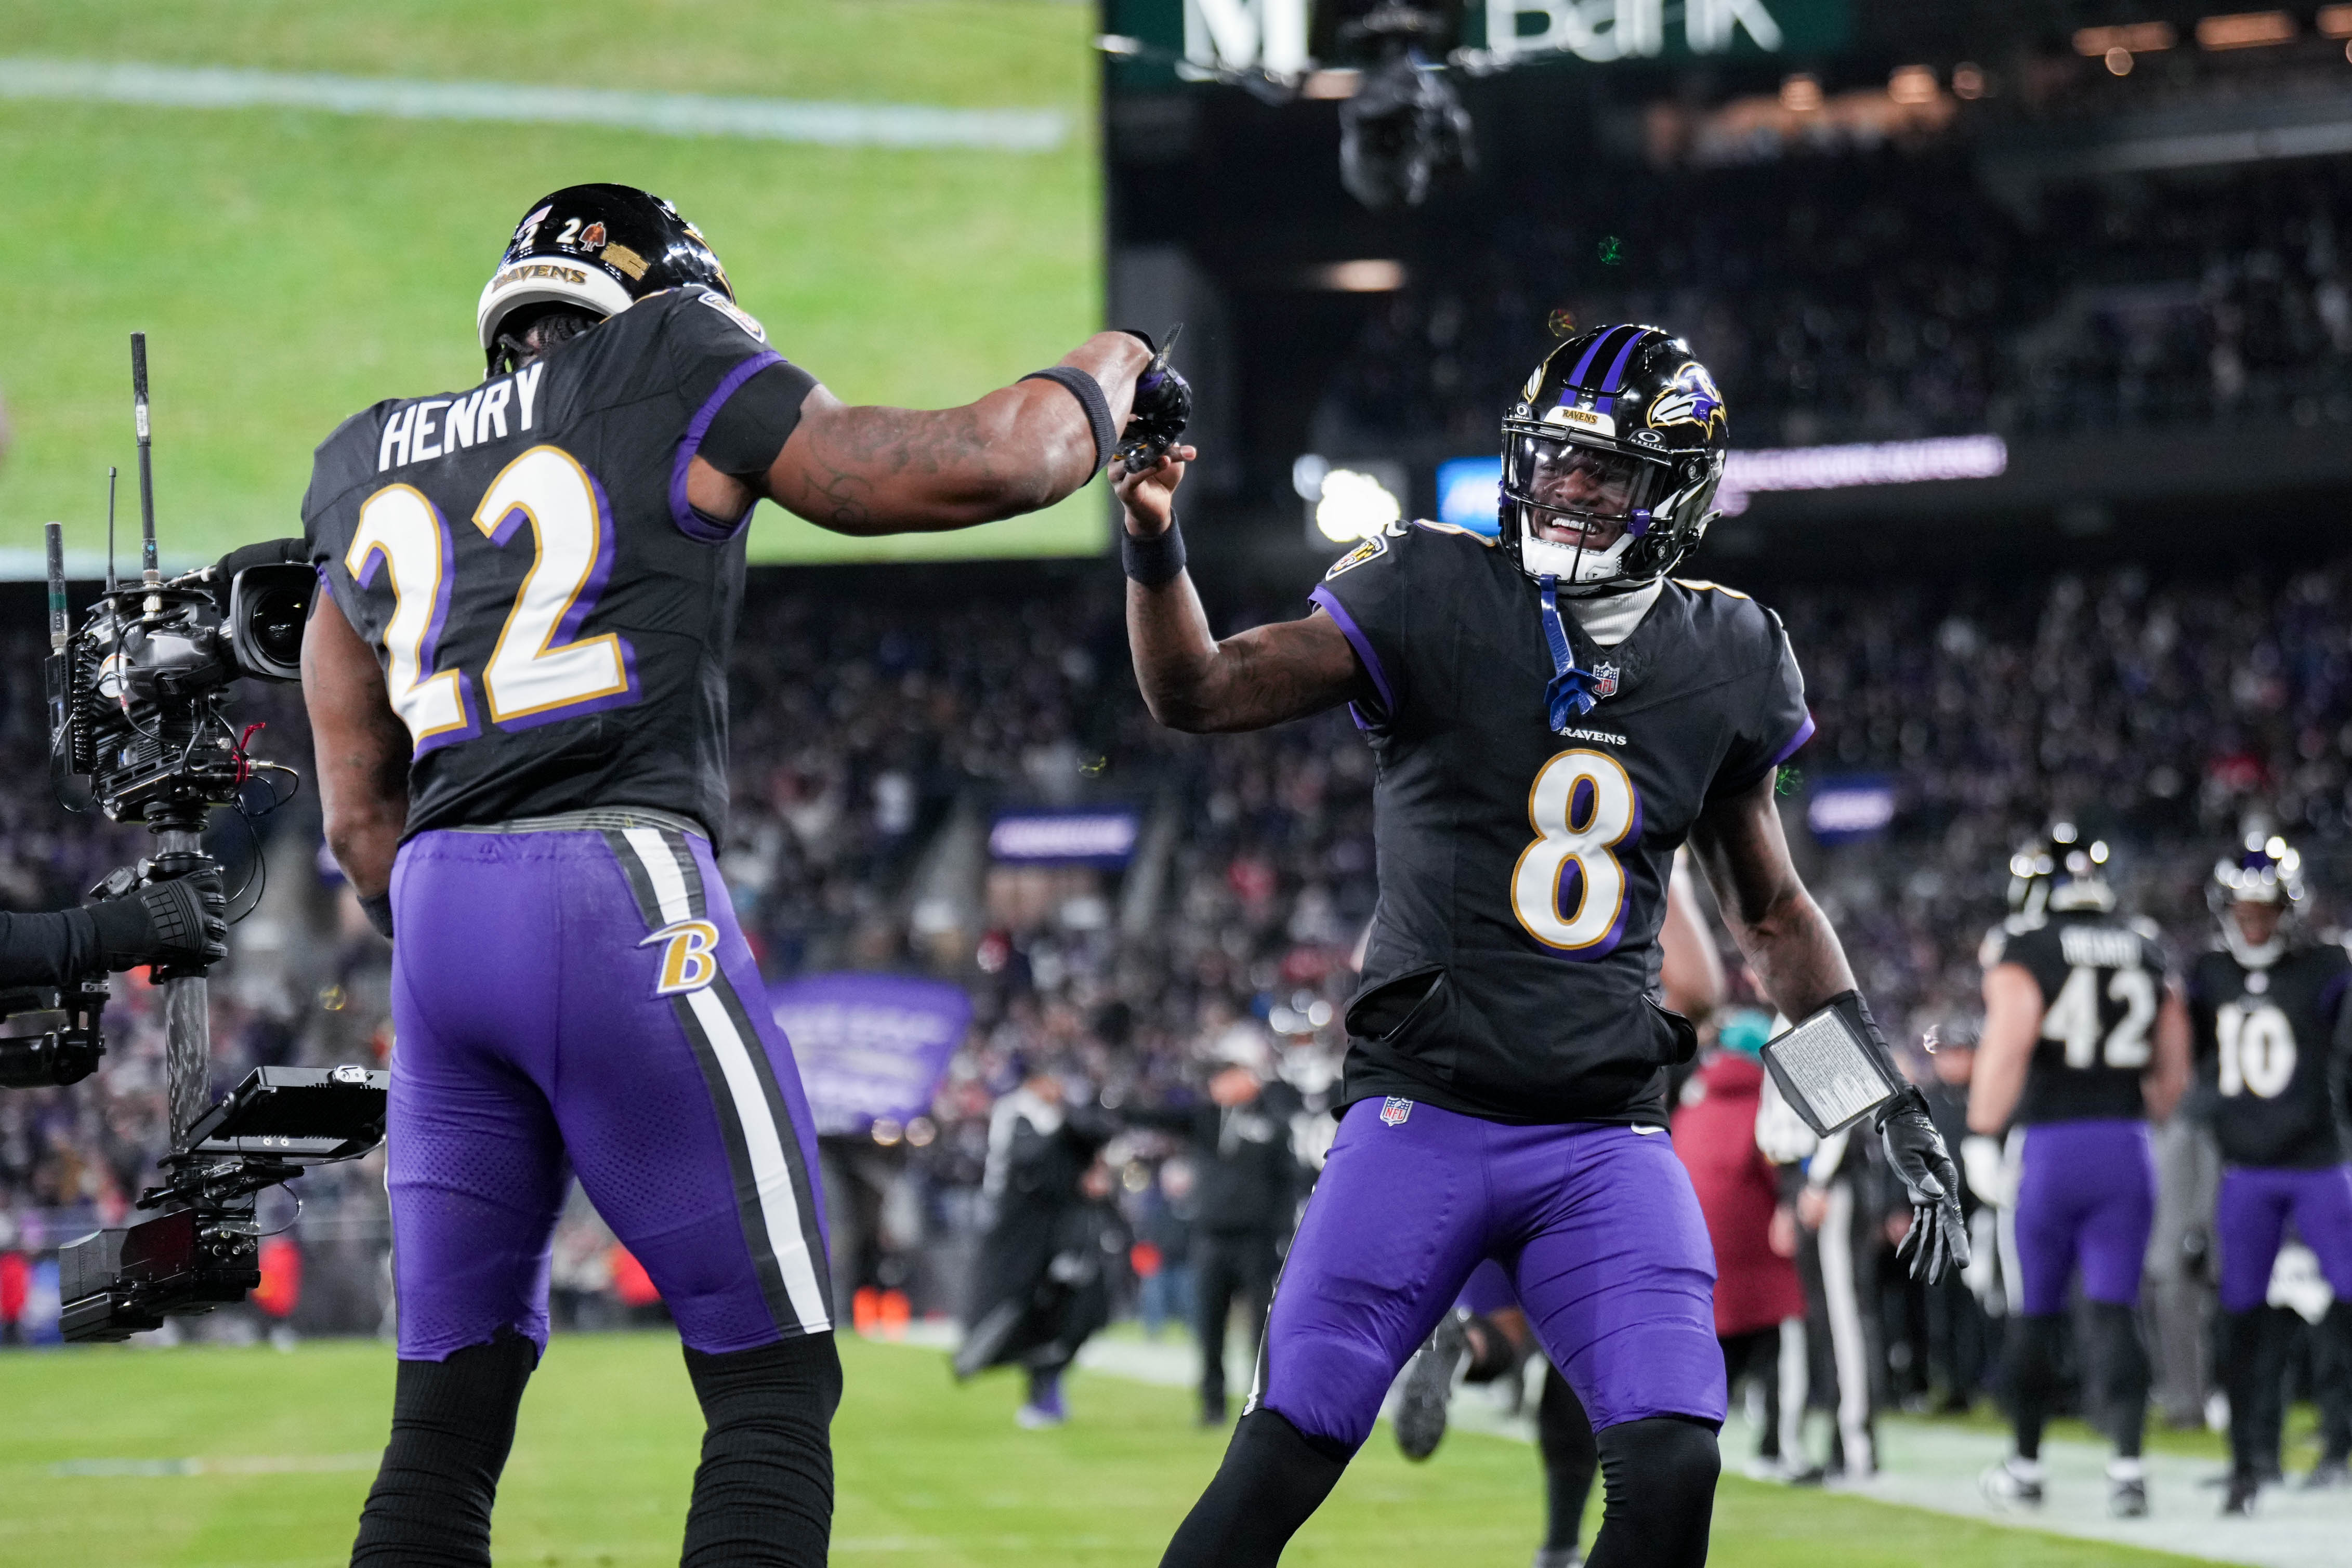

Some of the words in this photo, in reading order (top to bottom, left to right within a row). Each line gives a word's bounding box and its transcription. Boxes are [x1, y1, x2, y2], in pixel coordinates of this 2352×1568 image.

[378, 362, 544, 472] HENRY
[1562, 409, 1599, 425] RAVENS
[345, 445, 637, 749] 22
[1559, 727, 1627, 745] RAVENS
[1510, 748, 1637, 956] 8
[639, 919, 720, 994] B
[2043, 966, 2157, 1068] 42
[2216, 1003, 2296, 1098] 10
[1385, 1107, 1404, 1119] NFL
